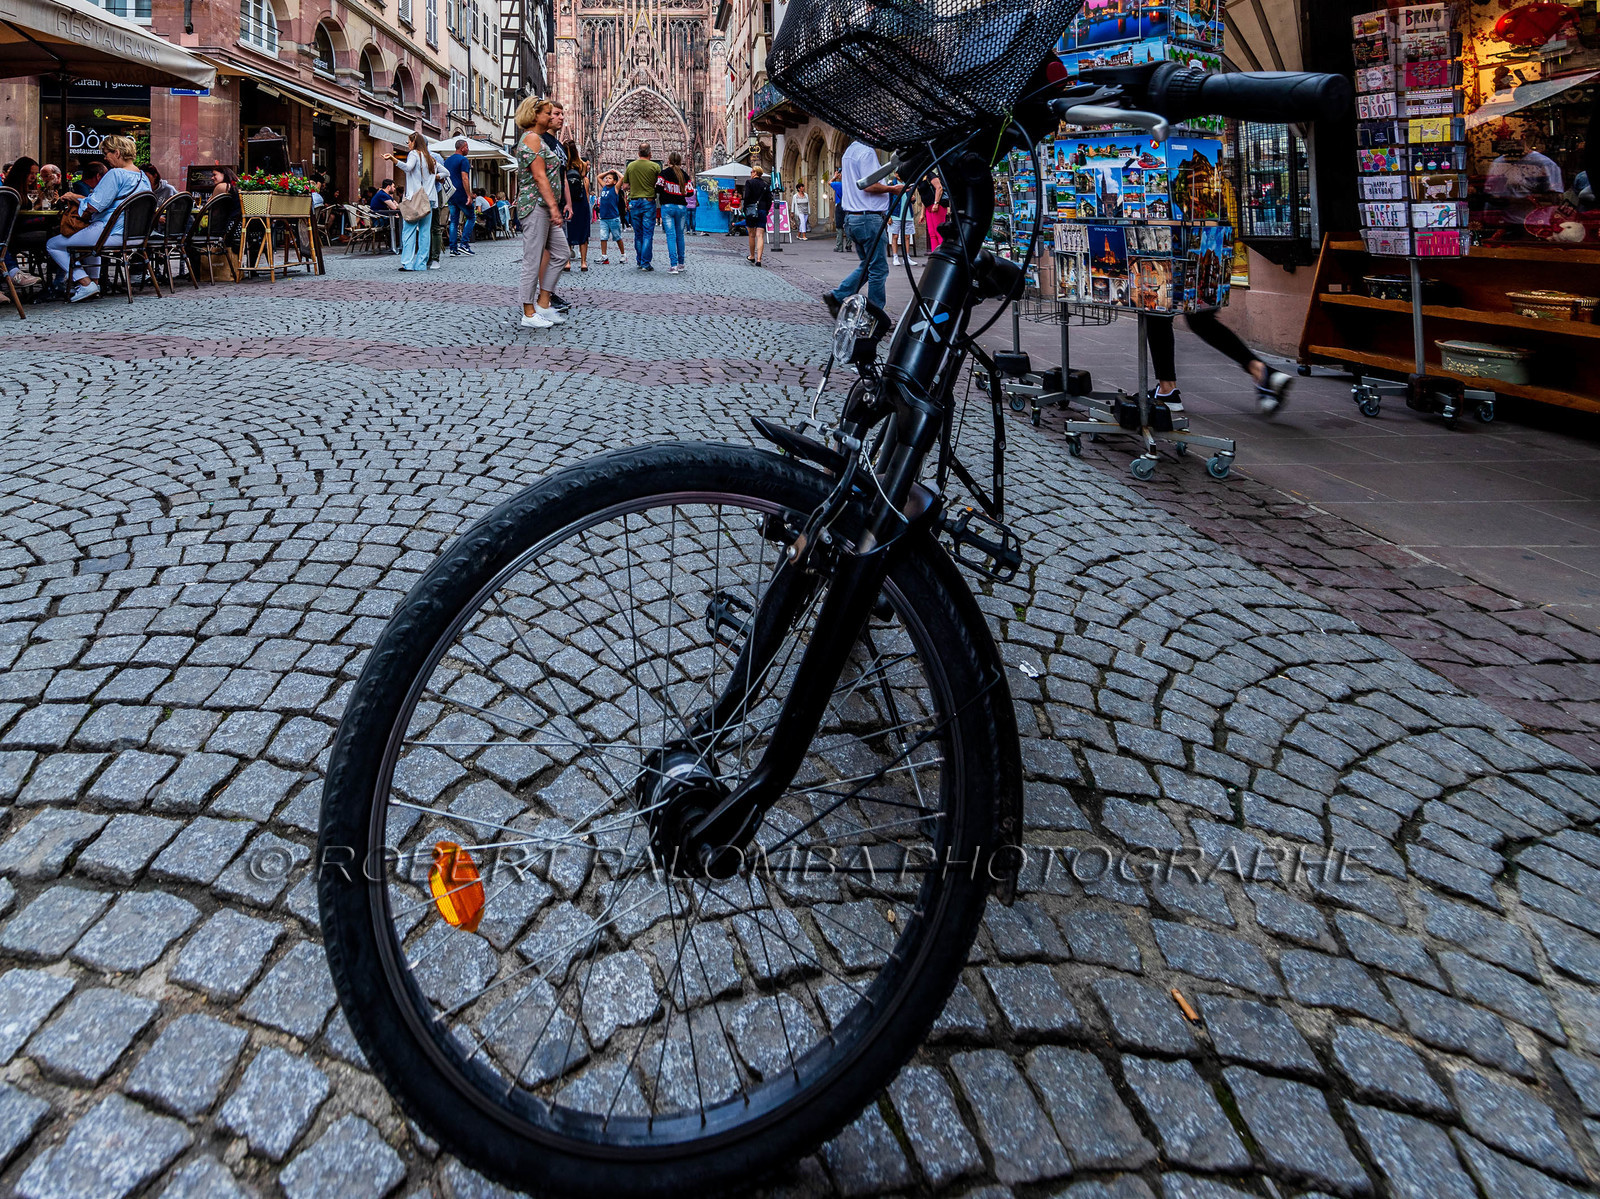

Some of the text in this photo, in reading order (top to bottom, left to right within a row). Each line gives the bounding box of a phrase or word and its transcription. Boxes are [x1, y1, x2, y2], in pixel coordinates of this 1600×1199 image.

[1405, 8, 1441, 26] BRAVO
[56, 10, 161, 65] RESTAURANT
[1361, 94, 1386, 105] GROS
[1361, 104, 1392, 117] BISOU
[1368, 204, 1395, 212] HAPPY
[1370, 211, 1398, 219] BIRTH
